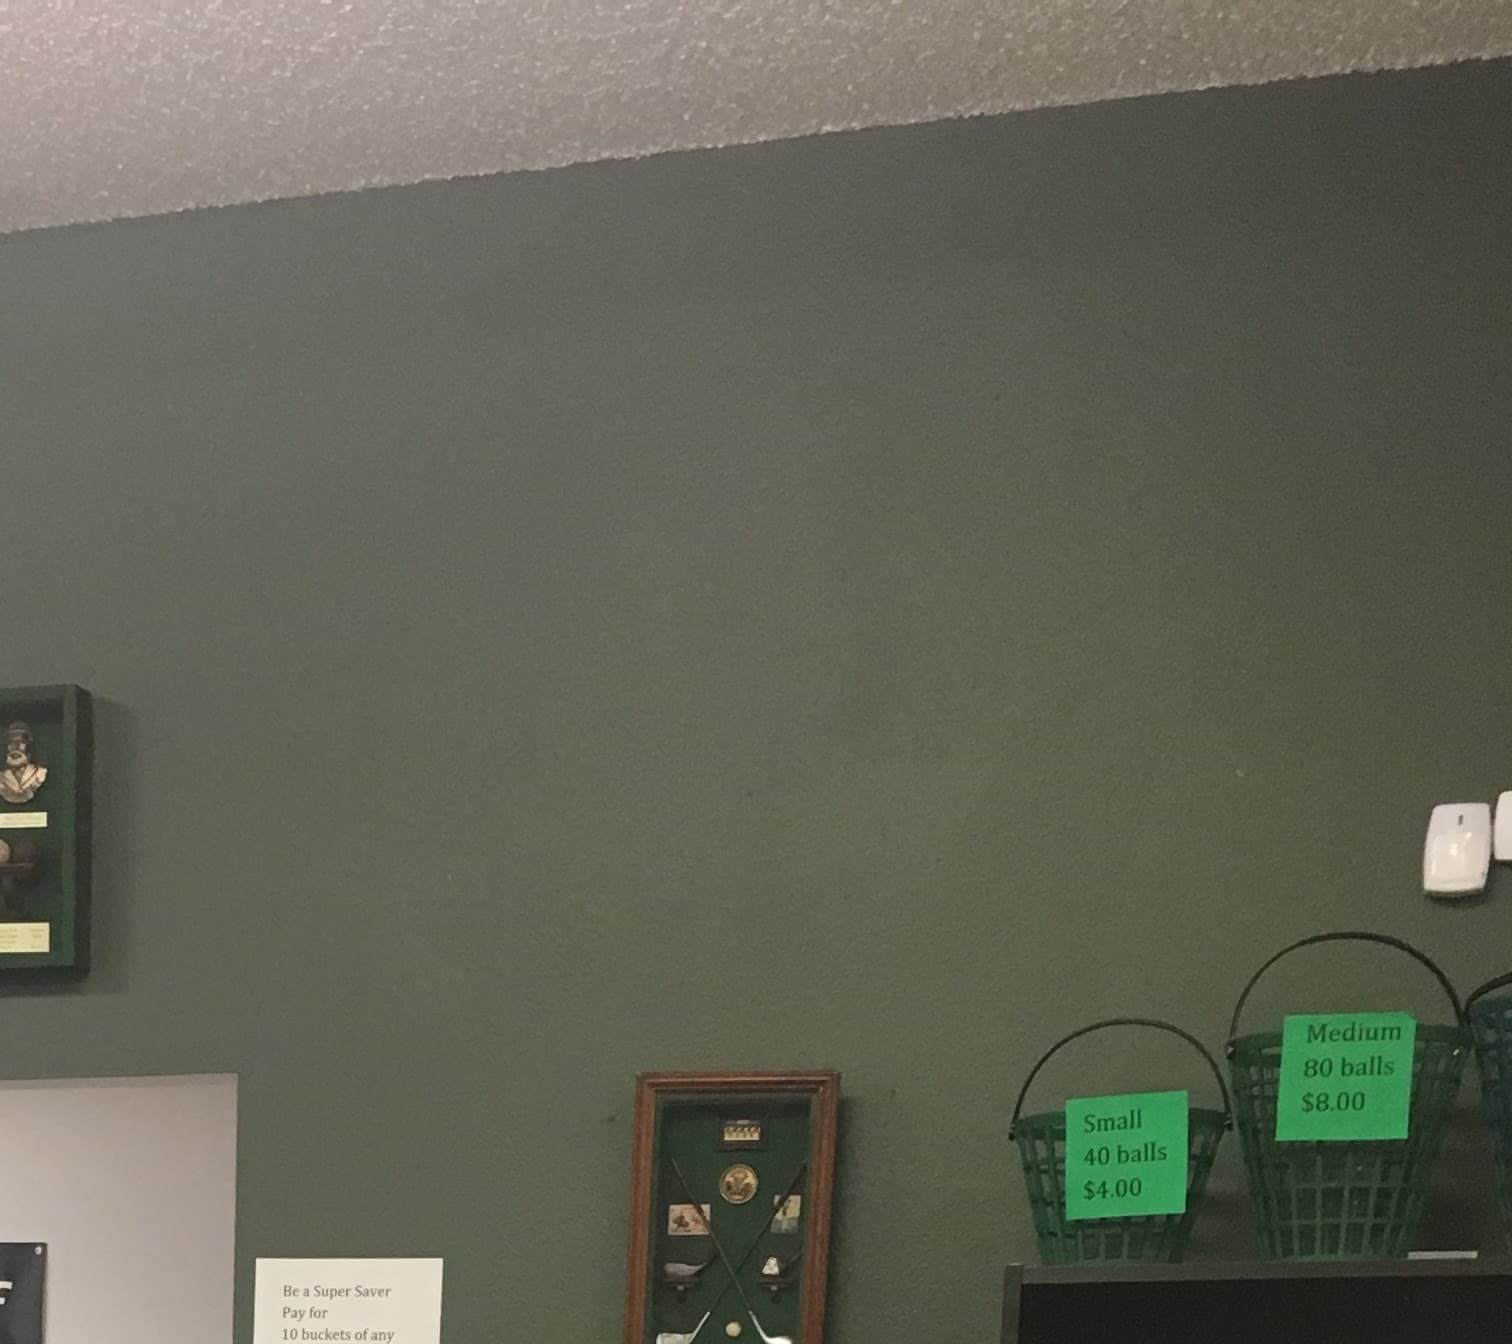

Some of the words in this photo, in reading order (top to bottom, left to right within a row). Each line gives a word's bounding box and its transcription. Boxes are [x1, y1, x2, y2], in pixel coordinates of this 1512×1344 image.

[1306, 1022, 1402, 1044] Medium
[1303, 1058, 1334, 1079] 80
[1340, 1056, 1395, 1077] balls
[1300, 1092, 1366, 1114] $8.00
[1083, 1110, 1143, 1135] Small
[1083, 1147, 1110, 1167] 40
[1116, 1142, 1168, 1165] balls
[1083, 1178, 1143, 1200] $4.00
[283, 1285, 299, 1298] Be
[302, 1288, 310, 1298] a
[313, 1285, 351, 1301] Super
[355, 1285, 392, 1298] Saver
[282, 1306, 306, 1322] Pay
[309, 1306, 328, 1319] for
[282, 1328, 298, 1341] 10
[301, 1327, 351, 1341] buckets
[354, 1327, 369, 1341] of
[370, 1331, 395, 1344] any
